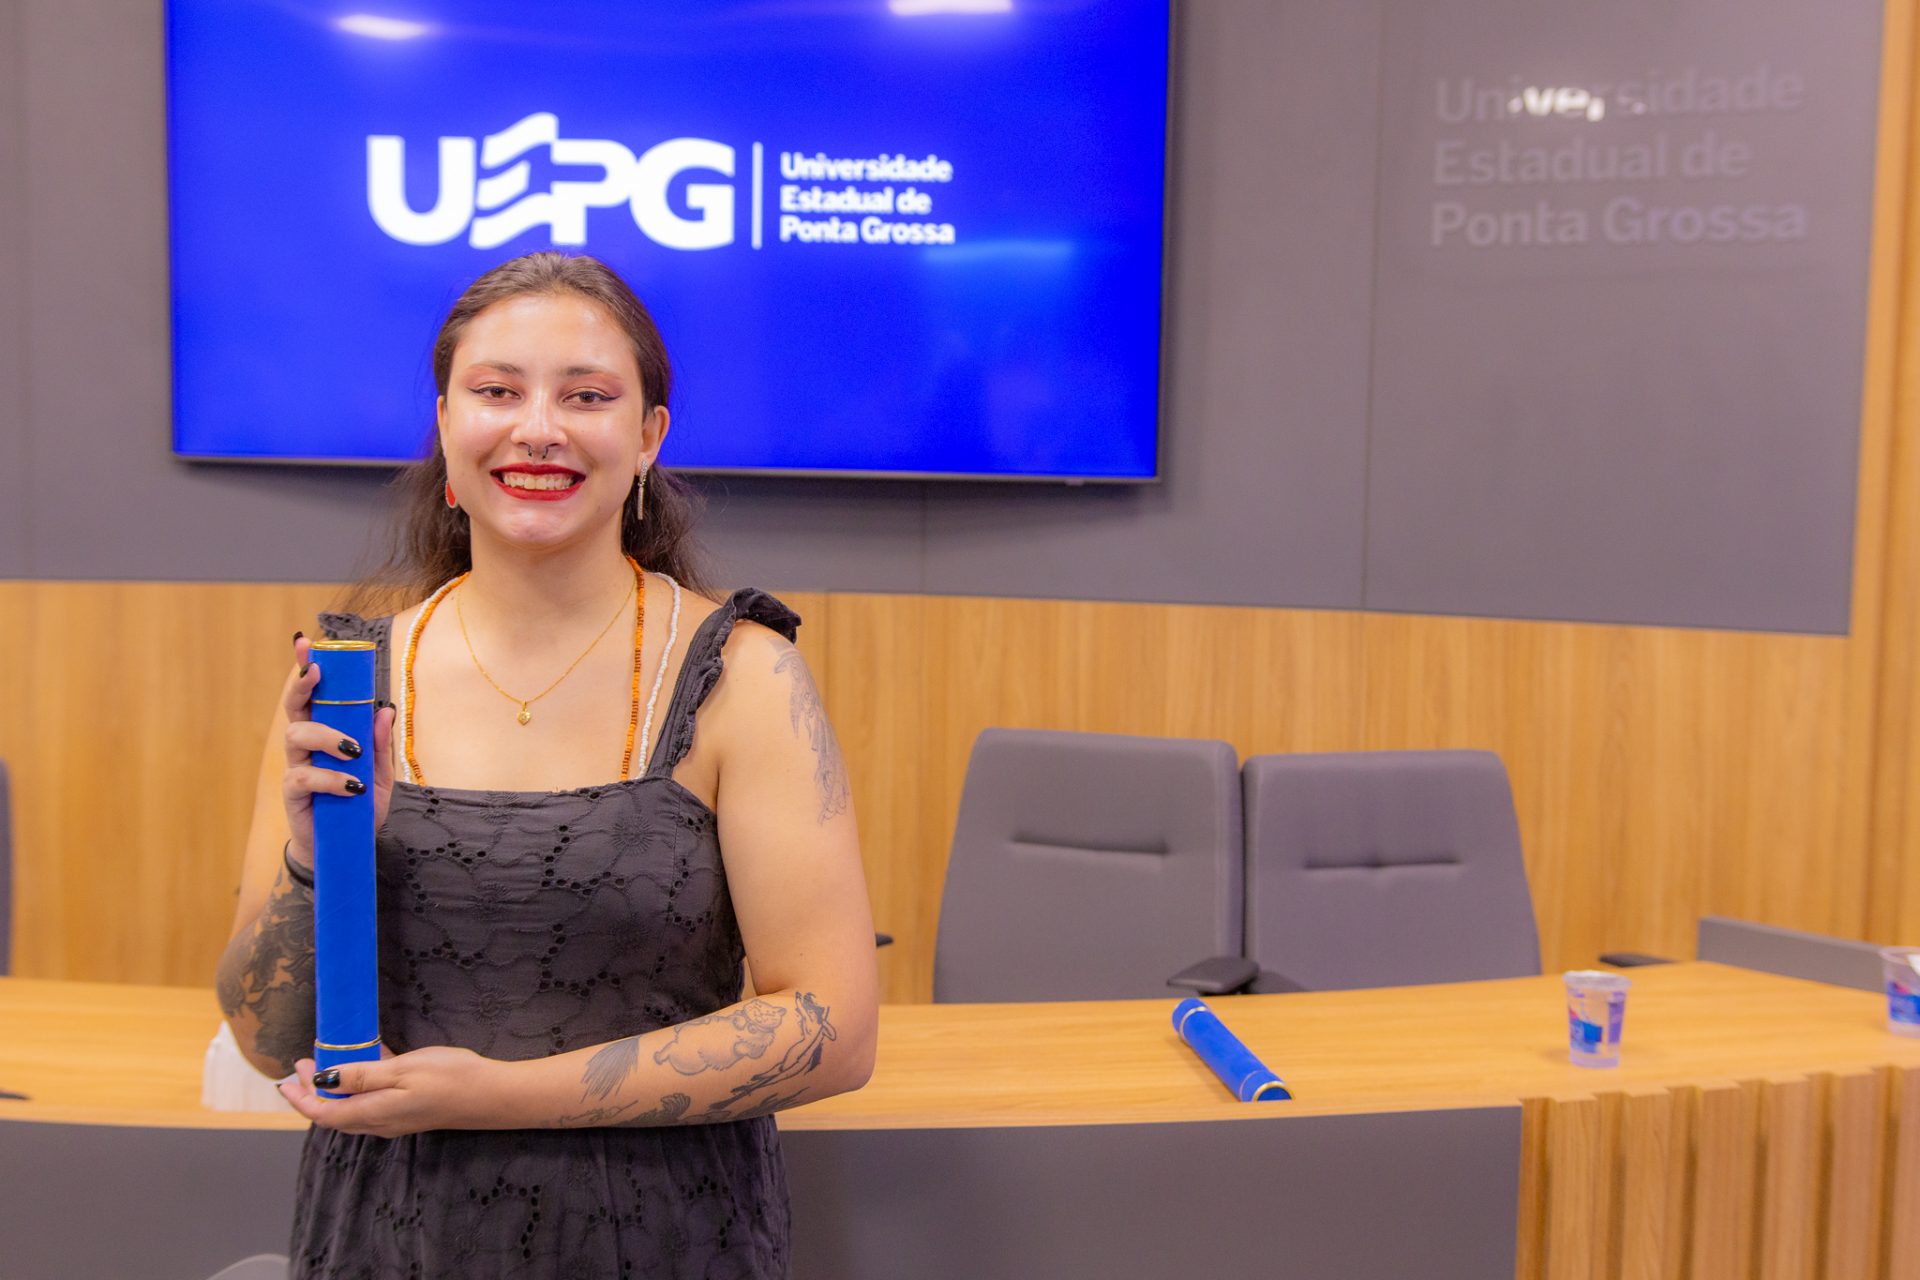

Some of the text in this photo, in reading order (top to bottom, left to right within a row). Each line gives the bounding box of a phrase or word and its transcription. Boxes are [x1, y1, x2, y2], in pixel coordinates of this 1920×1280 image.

[1436, 64, 1806, 124] Universidade
[366, 112, 736, 250] UEPG
[780, 152, 953, 182] Universidade
[1433, 128, 1751, 184] Estadual de
[780, 185, 932, 214] Estadual de
[1430, 197, 1808, 247] Ponta Grossa
[780, 215, 955, 244] Ponta Grossa
